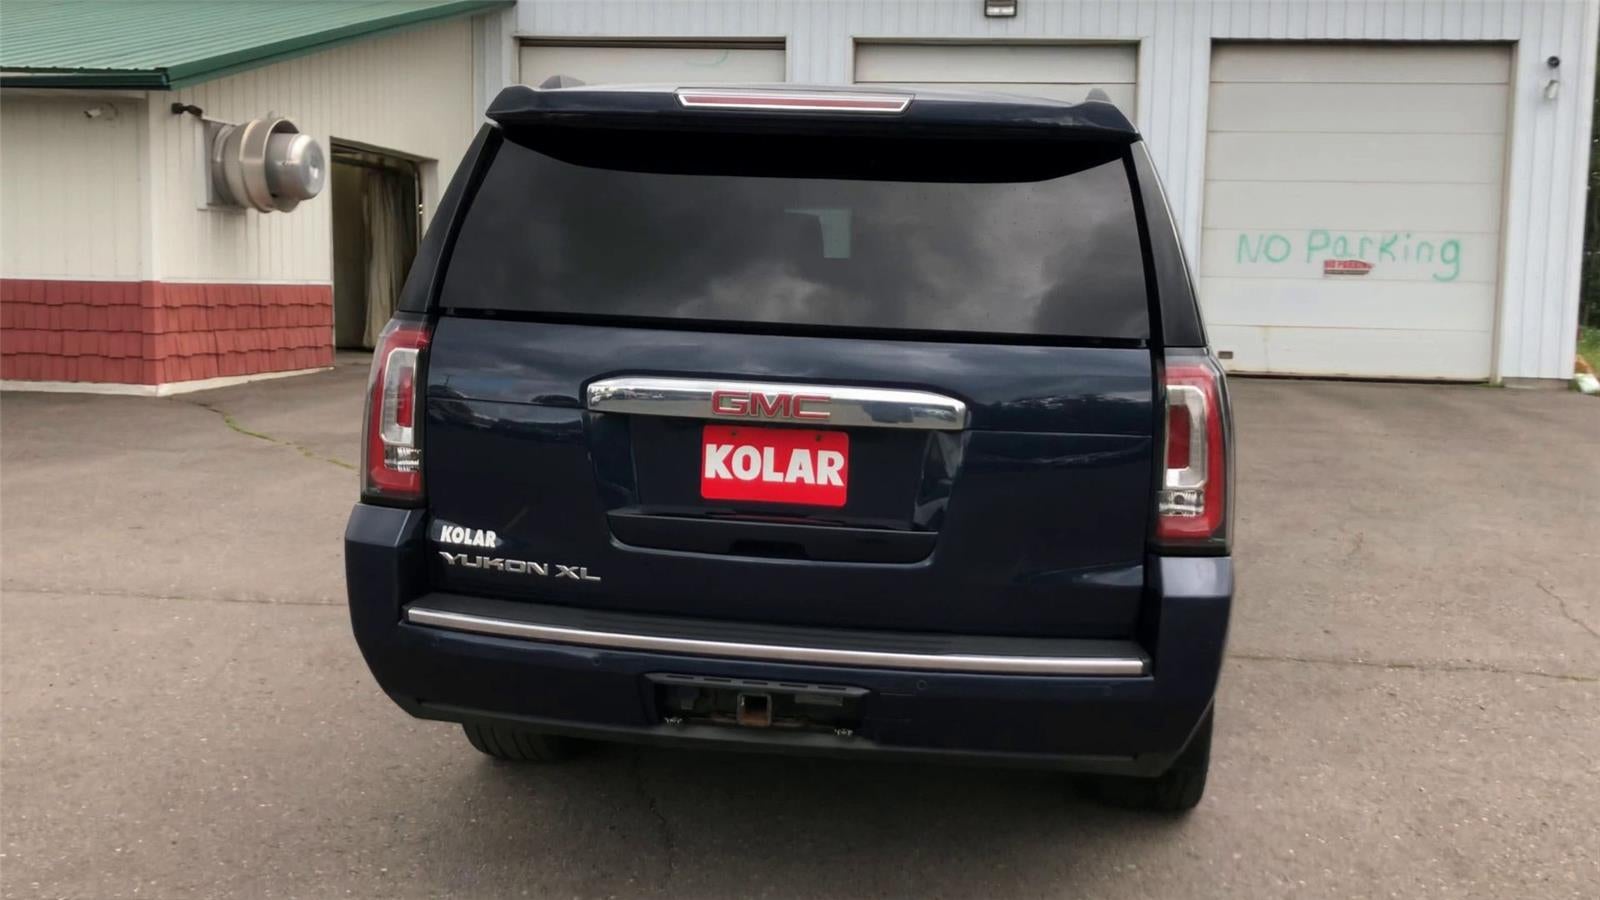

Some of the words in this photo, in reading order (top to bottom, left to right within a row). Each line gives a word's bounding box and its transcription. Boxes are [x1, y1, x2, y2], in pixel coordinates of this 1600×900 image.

[1236, 233, 1292, 264] NO
[711, 389, 832, 419] GMC
[704, 443, 845, 487] KOLAR
[440, 525, 497, 548] KOLAR
[438, 551, 548, 576] YUKON
[555, 564, 601, 581] XL
